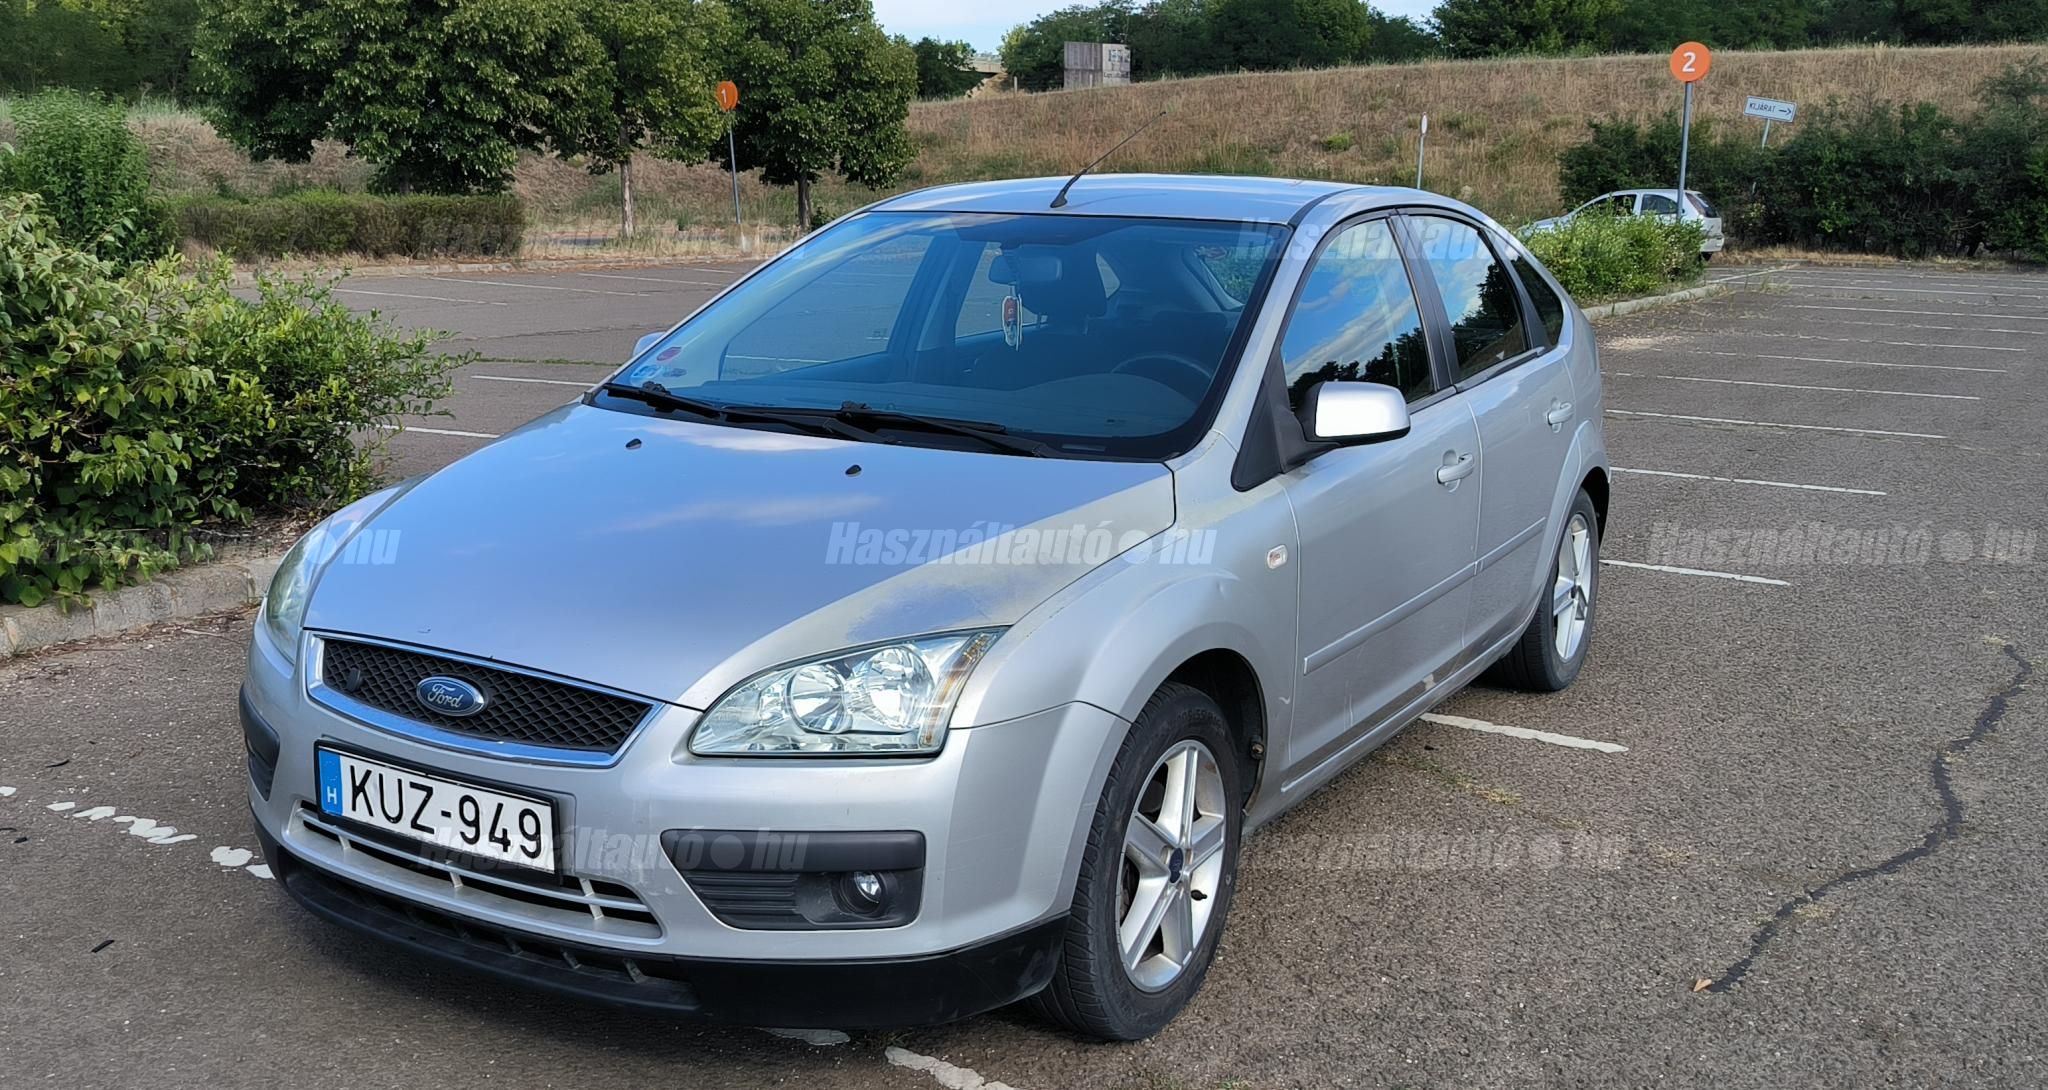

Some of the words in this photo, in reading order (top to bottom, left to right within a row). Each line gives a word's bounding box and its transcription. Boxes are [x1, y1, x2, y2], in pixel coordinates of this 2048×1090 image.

[1682, 52, 1696, 72] 2
[721, 89, 727, 104] 1
[427, 683, 464, 708] Ford
[327, 786, 337, 804] H
[350, 765, 542, 860] KUZ-949
